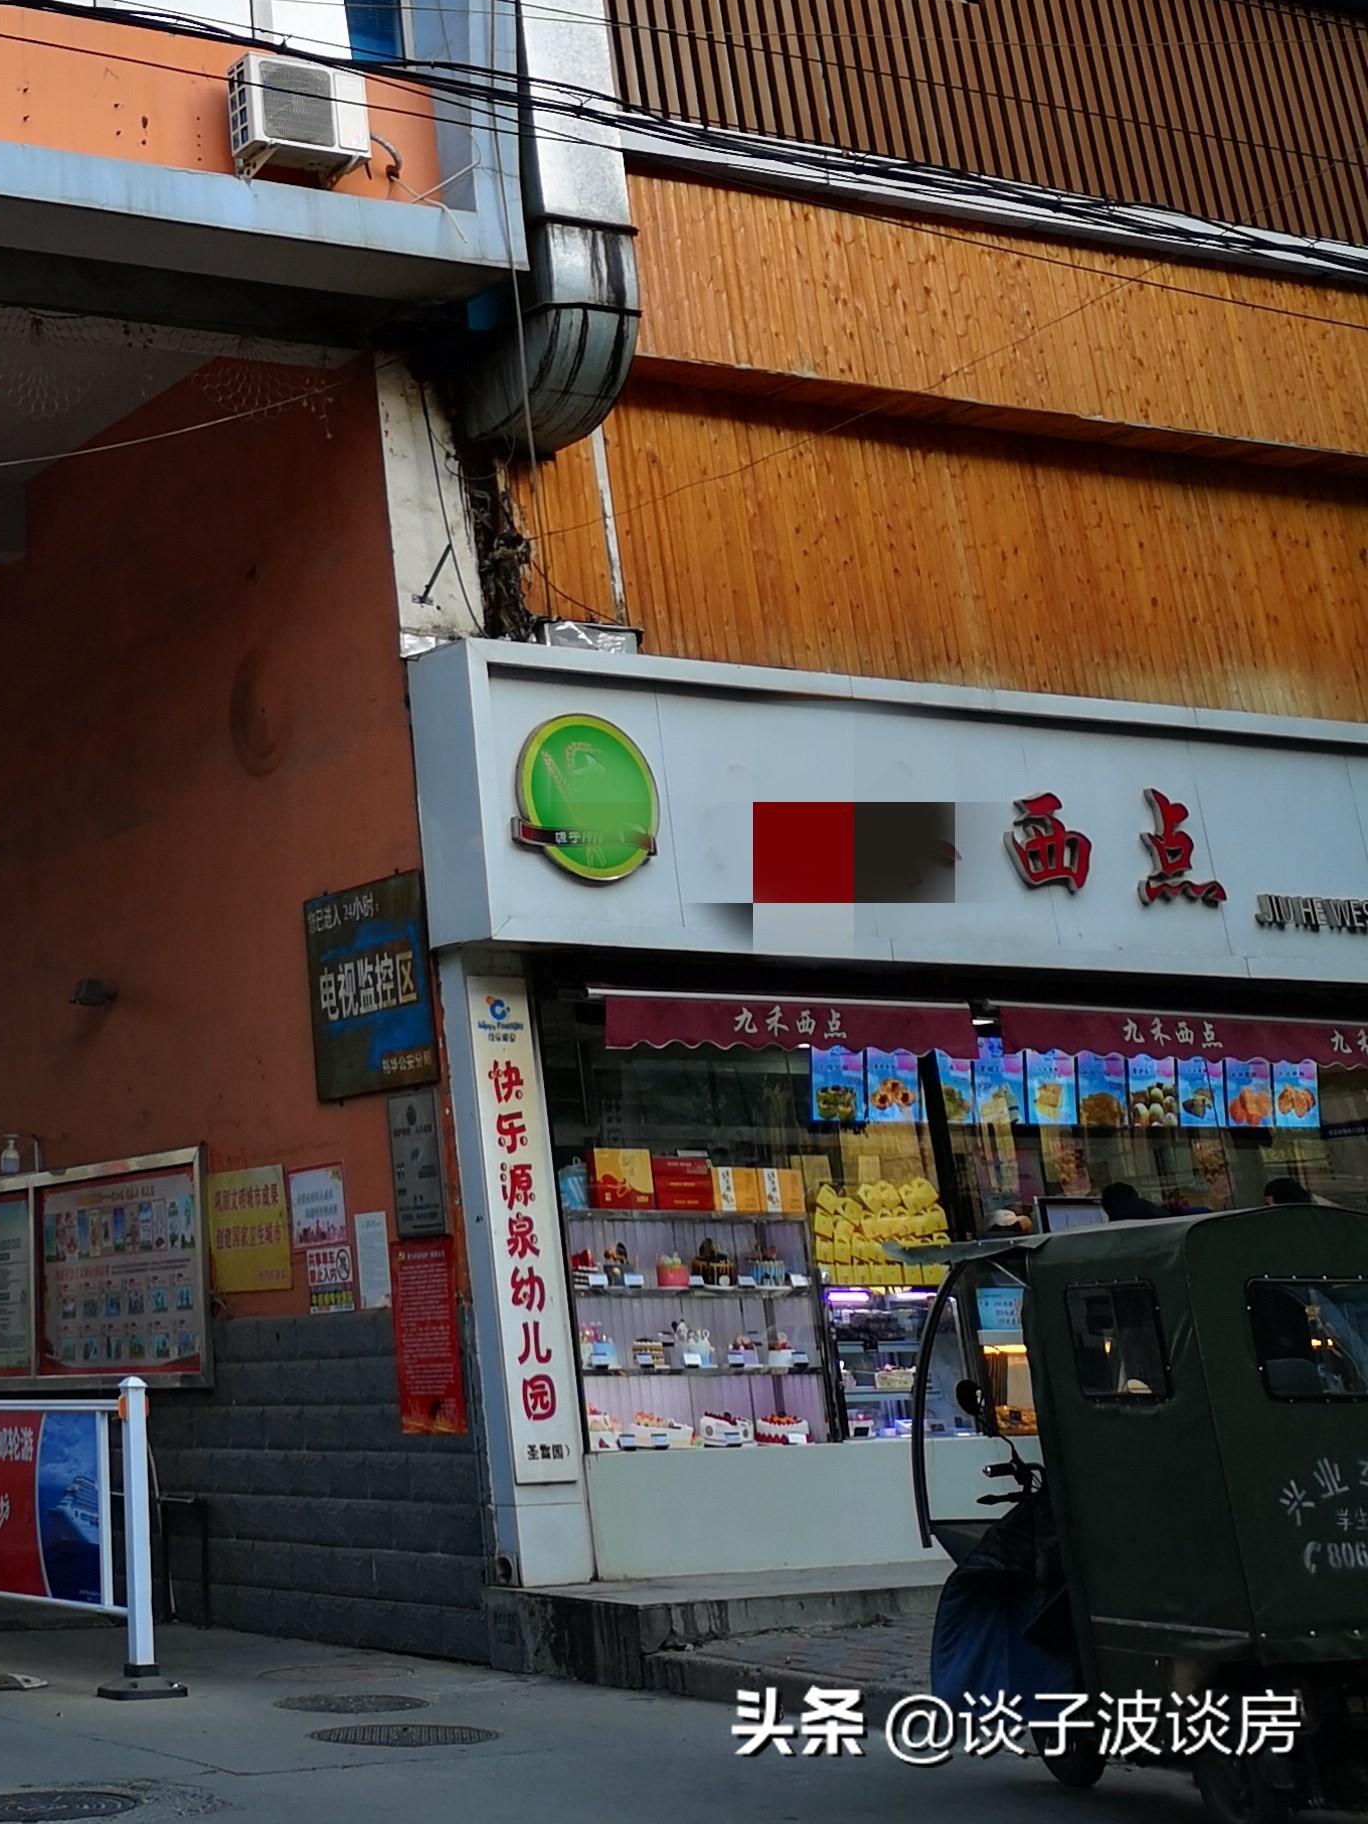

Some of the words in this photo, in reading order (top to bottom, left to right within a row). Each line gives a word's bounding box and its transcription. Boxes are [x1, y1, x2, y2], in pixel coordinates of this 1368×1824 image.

[1003, 787, 1226, 907] 西点
[320, 950, 419, 1021] 电视监控区
[734, 1004, 848, 1040] 九禾西点
[1123, 1017, 1224, 1049] 九禾西点
[488, 1060, 557, 1421] 快乐源泉幼儿园
